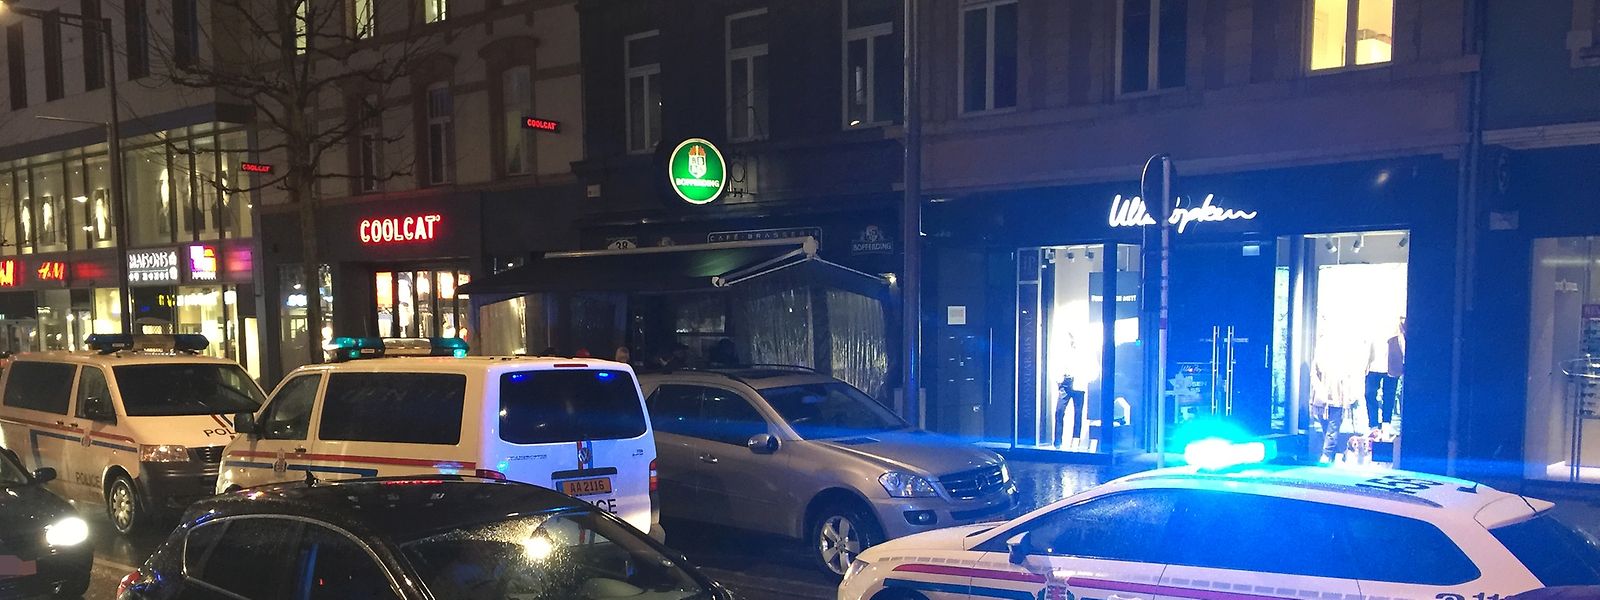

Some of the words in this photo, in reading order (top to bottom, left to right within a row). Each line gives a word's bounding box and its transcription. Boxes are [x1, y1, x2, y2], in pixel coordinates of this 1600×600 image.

[527, 119, 557, 130] COOLCAT
[242, 164, 270, 172] COOLCAT
[361, 215, 440, 242] COOLCAT
[38, 262, 65, 280] H&M
[203, 428, 237, 437] POL
[76, 471, 102, 489] POLICE
[570, 480, 582, 493] AA
[584, 480, 605, 492] 2116
